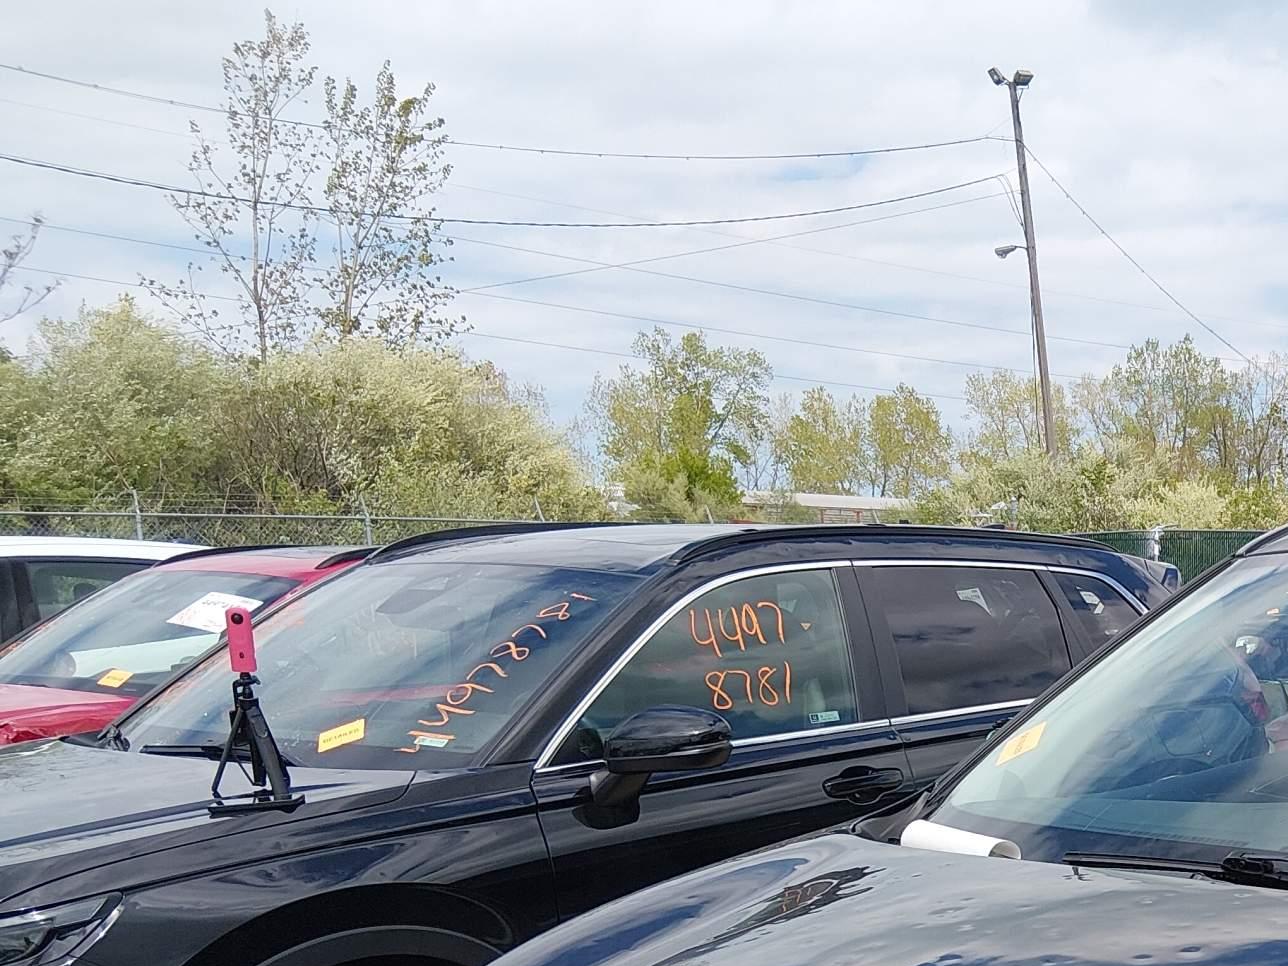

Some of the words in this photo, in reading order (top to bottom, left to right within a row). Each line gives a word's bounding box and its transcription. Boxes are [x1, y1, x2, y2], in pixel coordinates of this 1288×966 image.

[690, 602, 785, 657] 4497
[393, 593, 599, 753] 44978781
[705, 661, 791, 710] 8781
